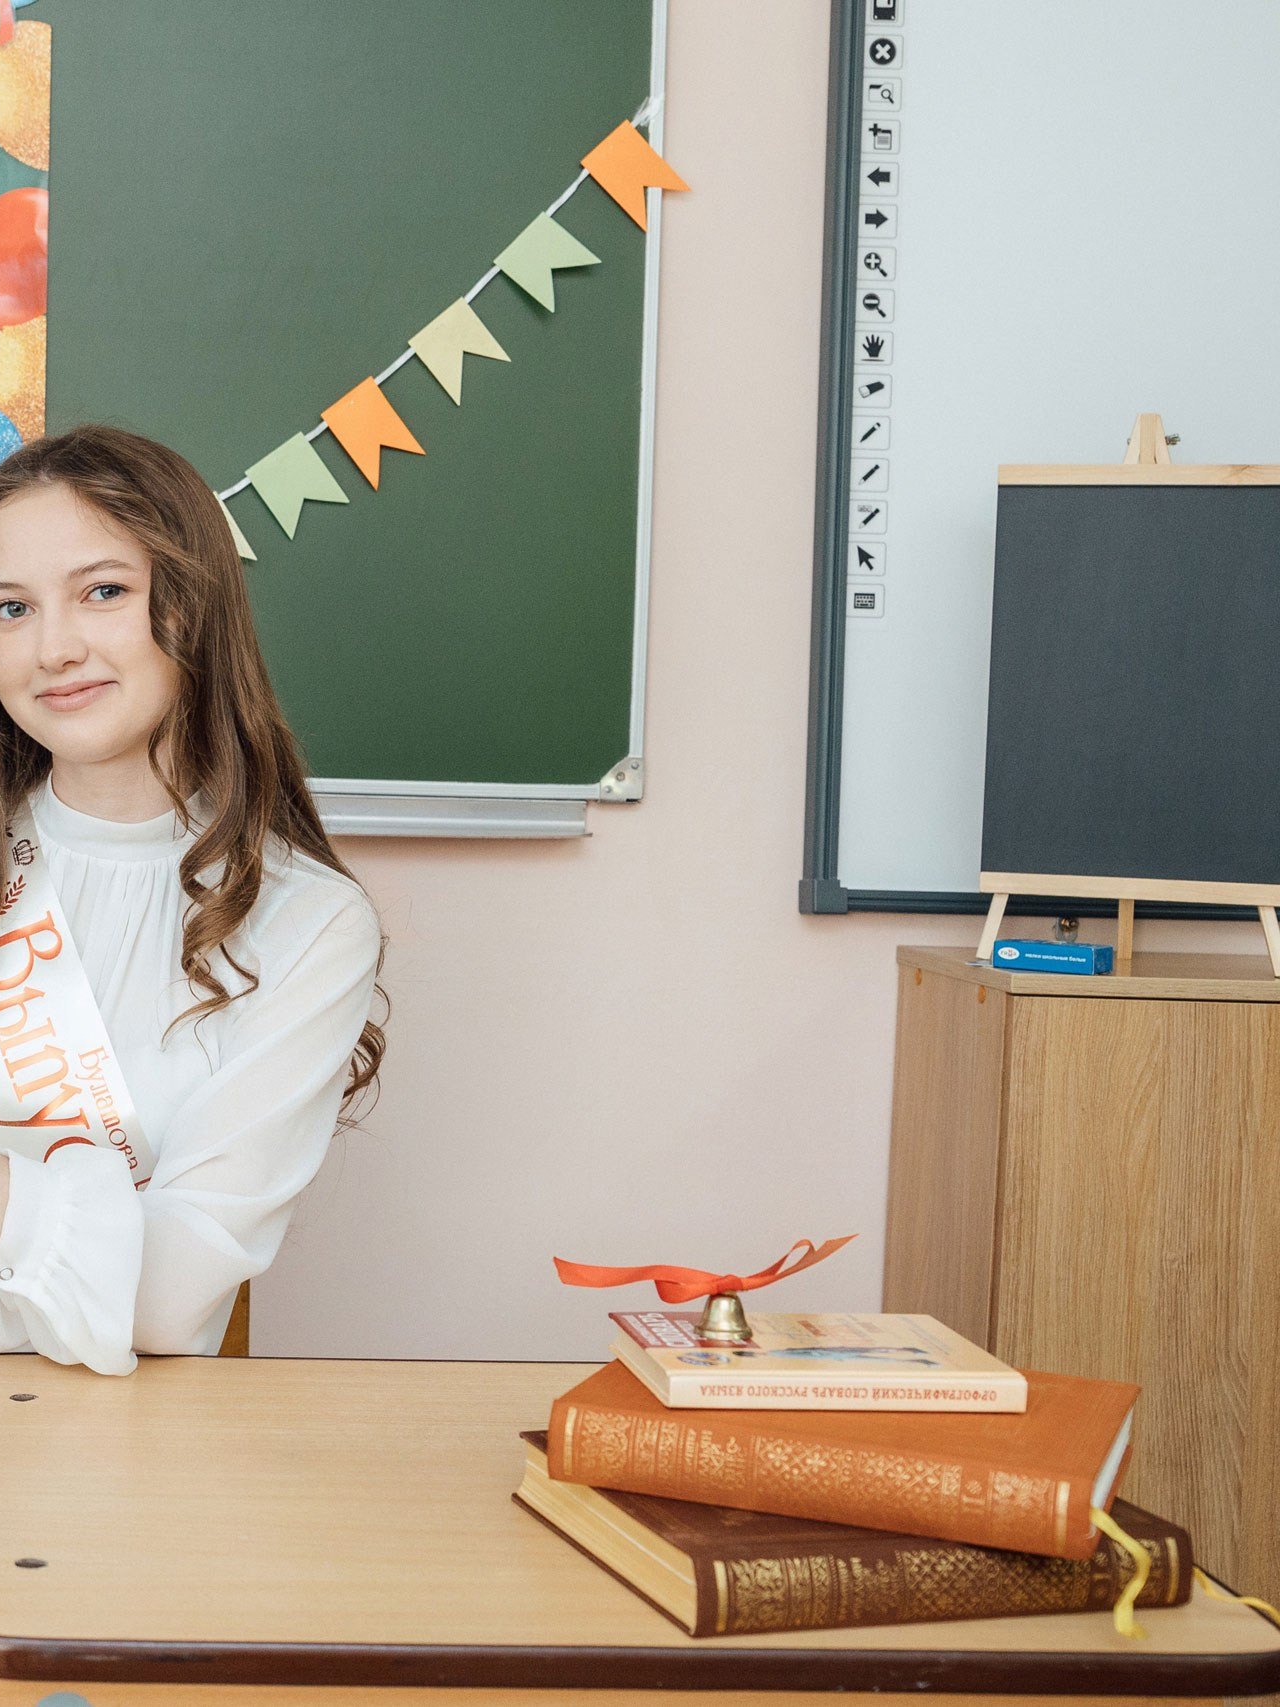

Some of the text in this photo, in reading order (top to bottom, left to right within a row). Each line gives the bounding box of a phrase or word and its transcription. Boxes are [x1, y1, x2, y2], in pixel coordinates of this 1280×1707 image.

[700, 1384, 997, 1401] ОРФОГРАФИЧЕСКИЙ СЛОВАРЬ РУССКОГО ЯЗЫКА
